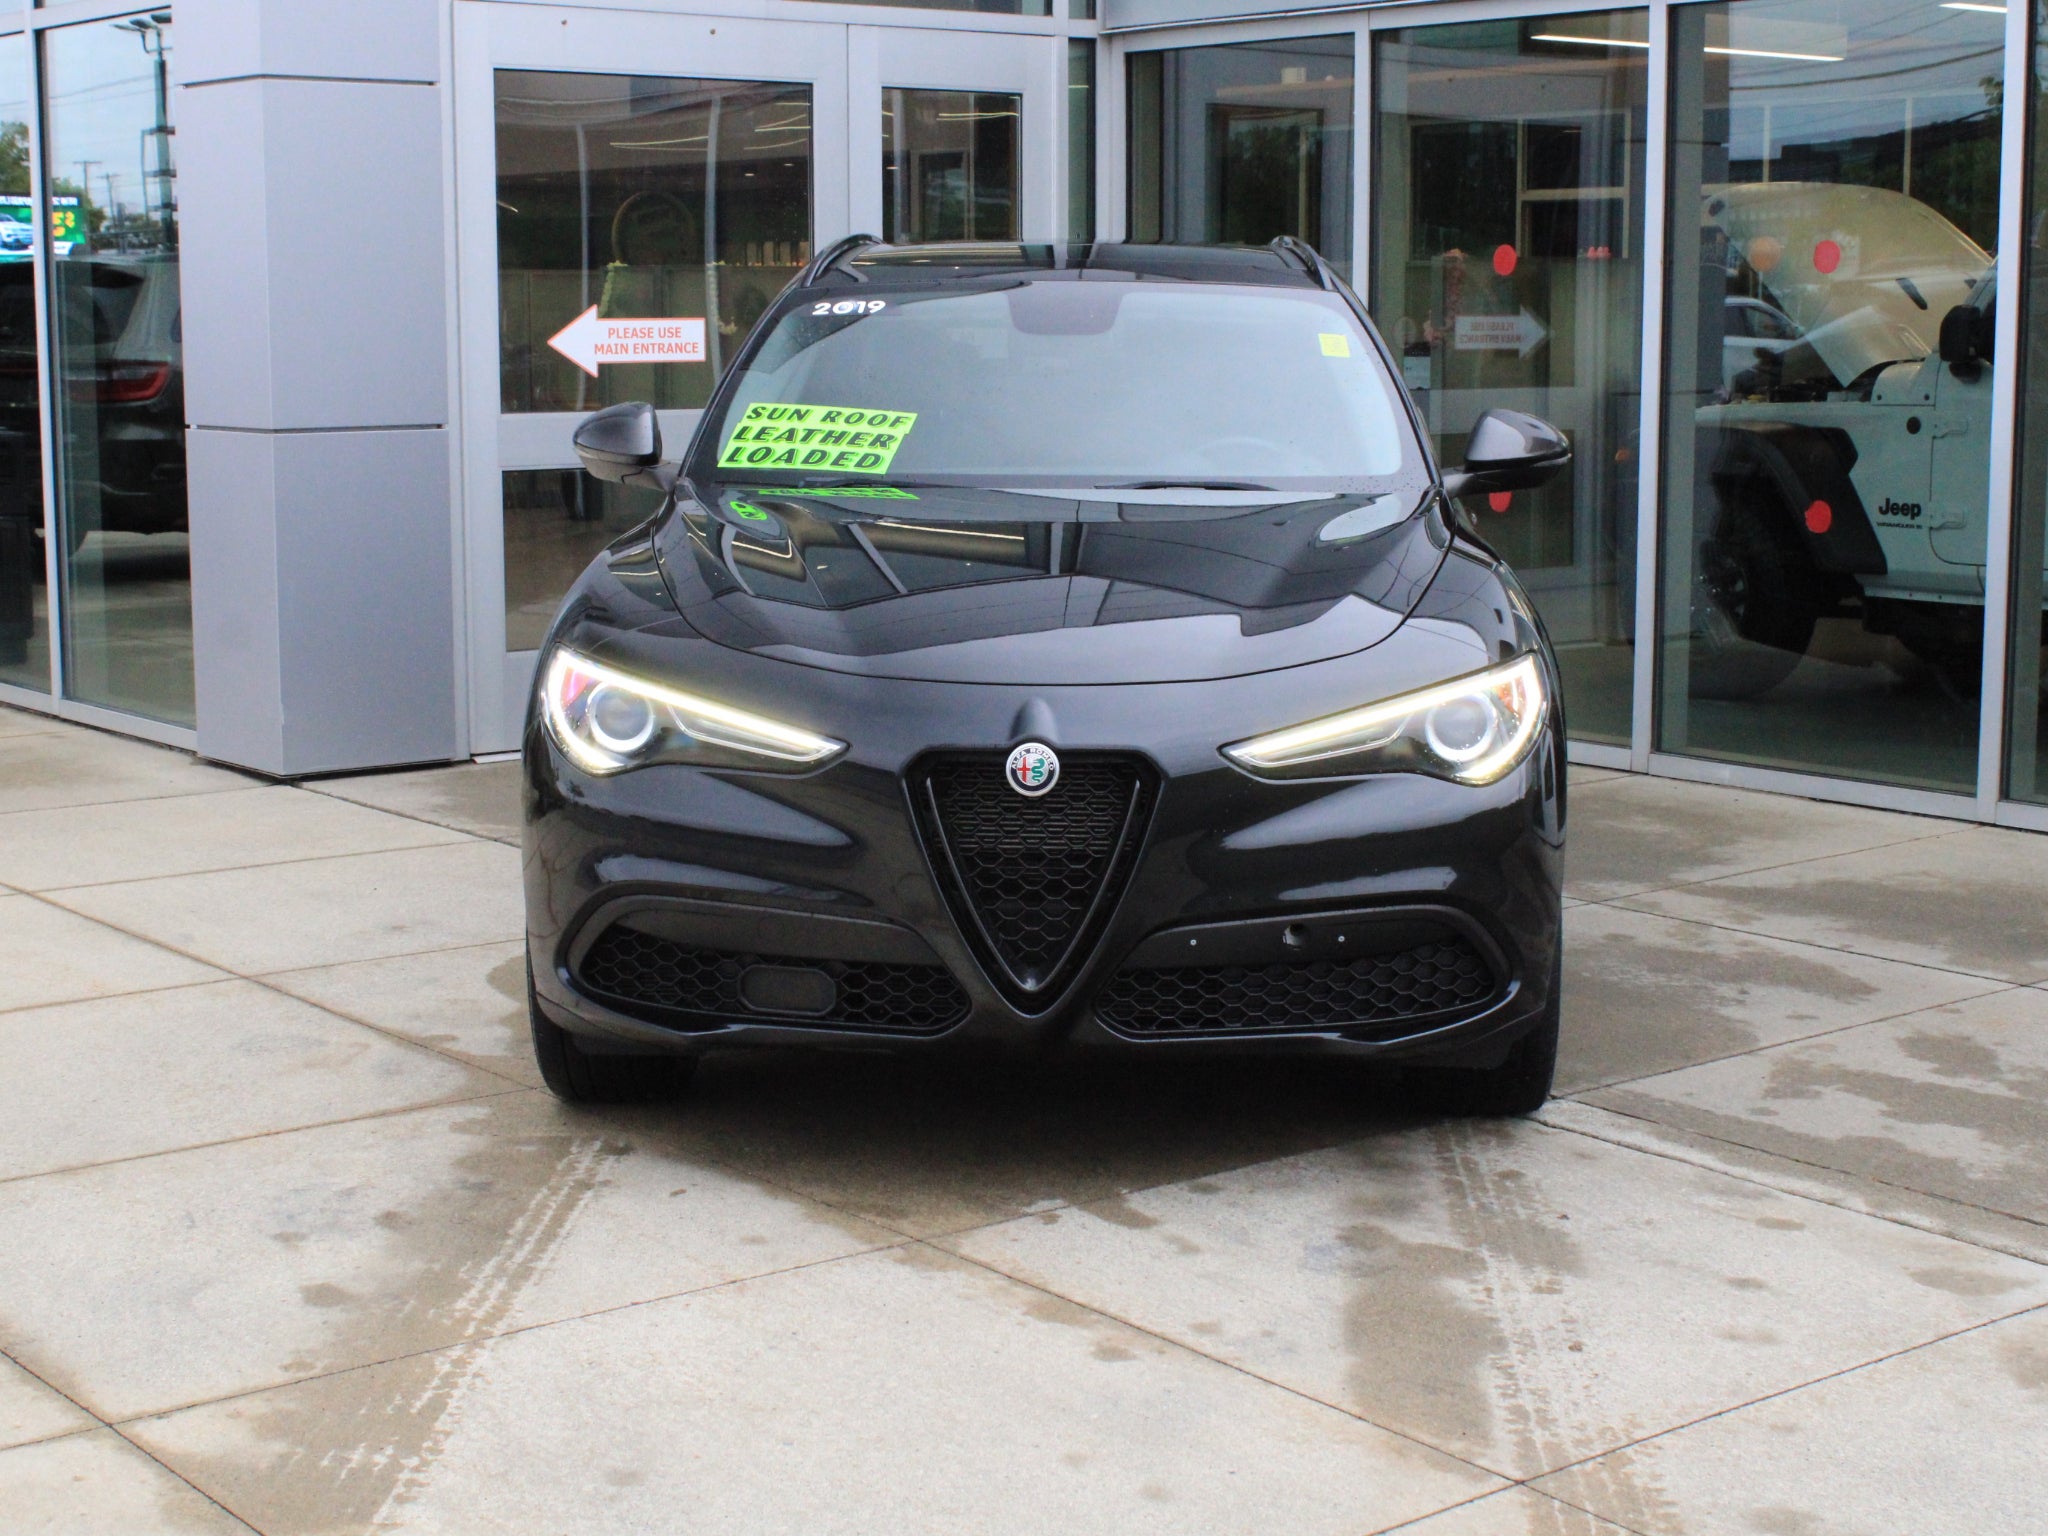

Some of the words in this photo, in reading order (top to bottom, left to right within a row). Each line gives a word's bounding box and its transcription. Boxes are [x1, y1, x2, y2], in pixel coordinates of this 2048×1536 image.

[812, 300, 886, 315] 2019
[607, 327, 654, 339] PLEASE
[658, 327, 682, 339] USE
[594, 343, 629, 355] MAIN
[633, 342, 699, 355] ENTRANCE
[746, 406, 812, 423] SUN
[820, 410, 911, 429] ROOF
[733, 425, 898, 449] LEATHER
[725, 446, 884, 469] LOADED
[1878, 497, 1922, 520] Jeep
